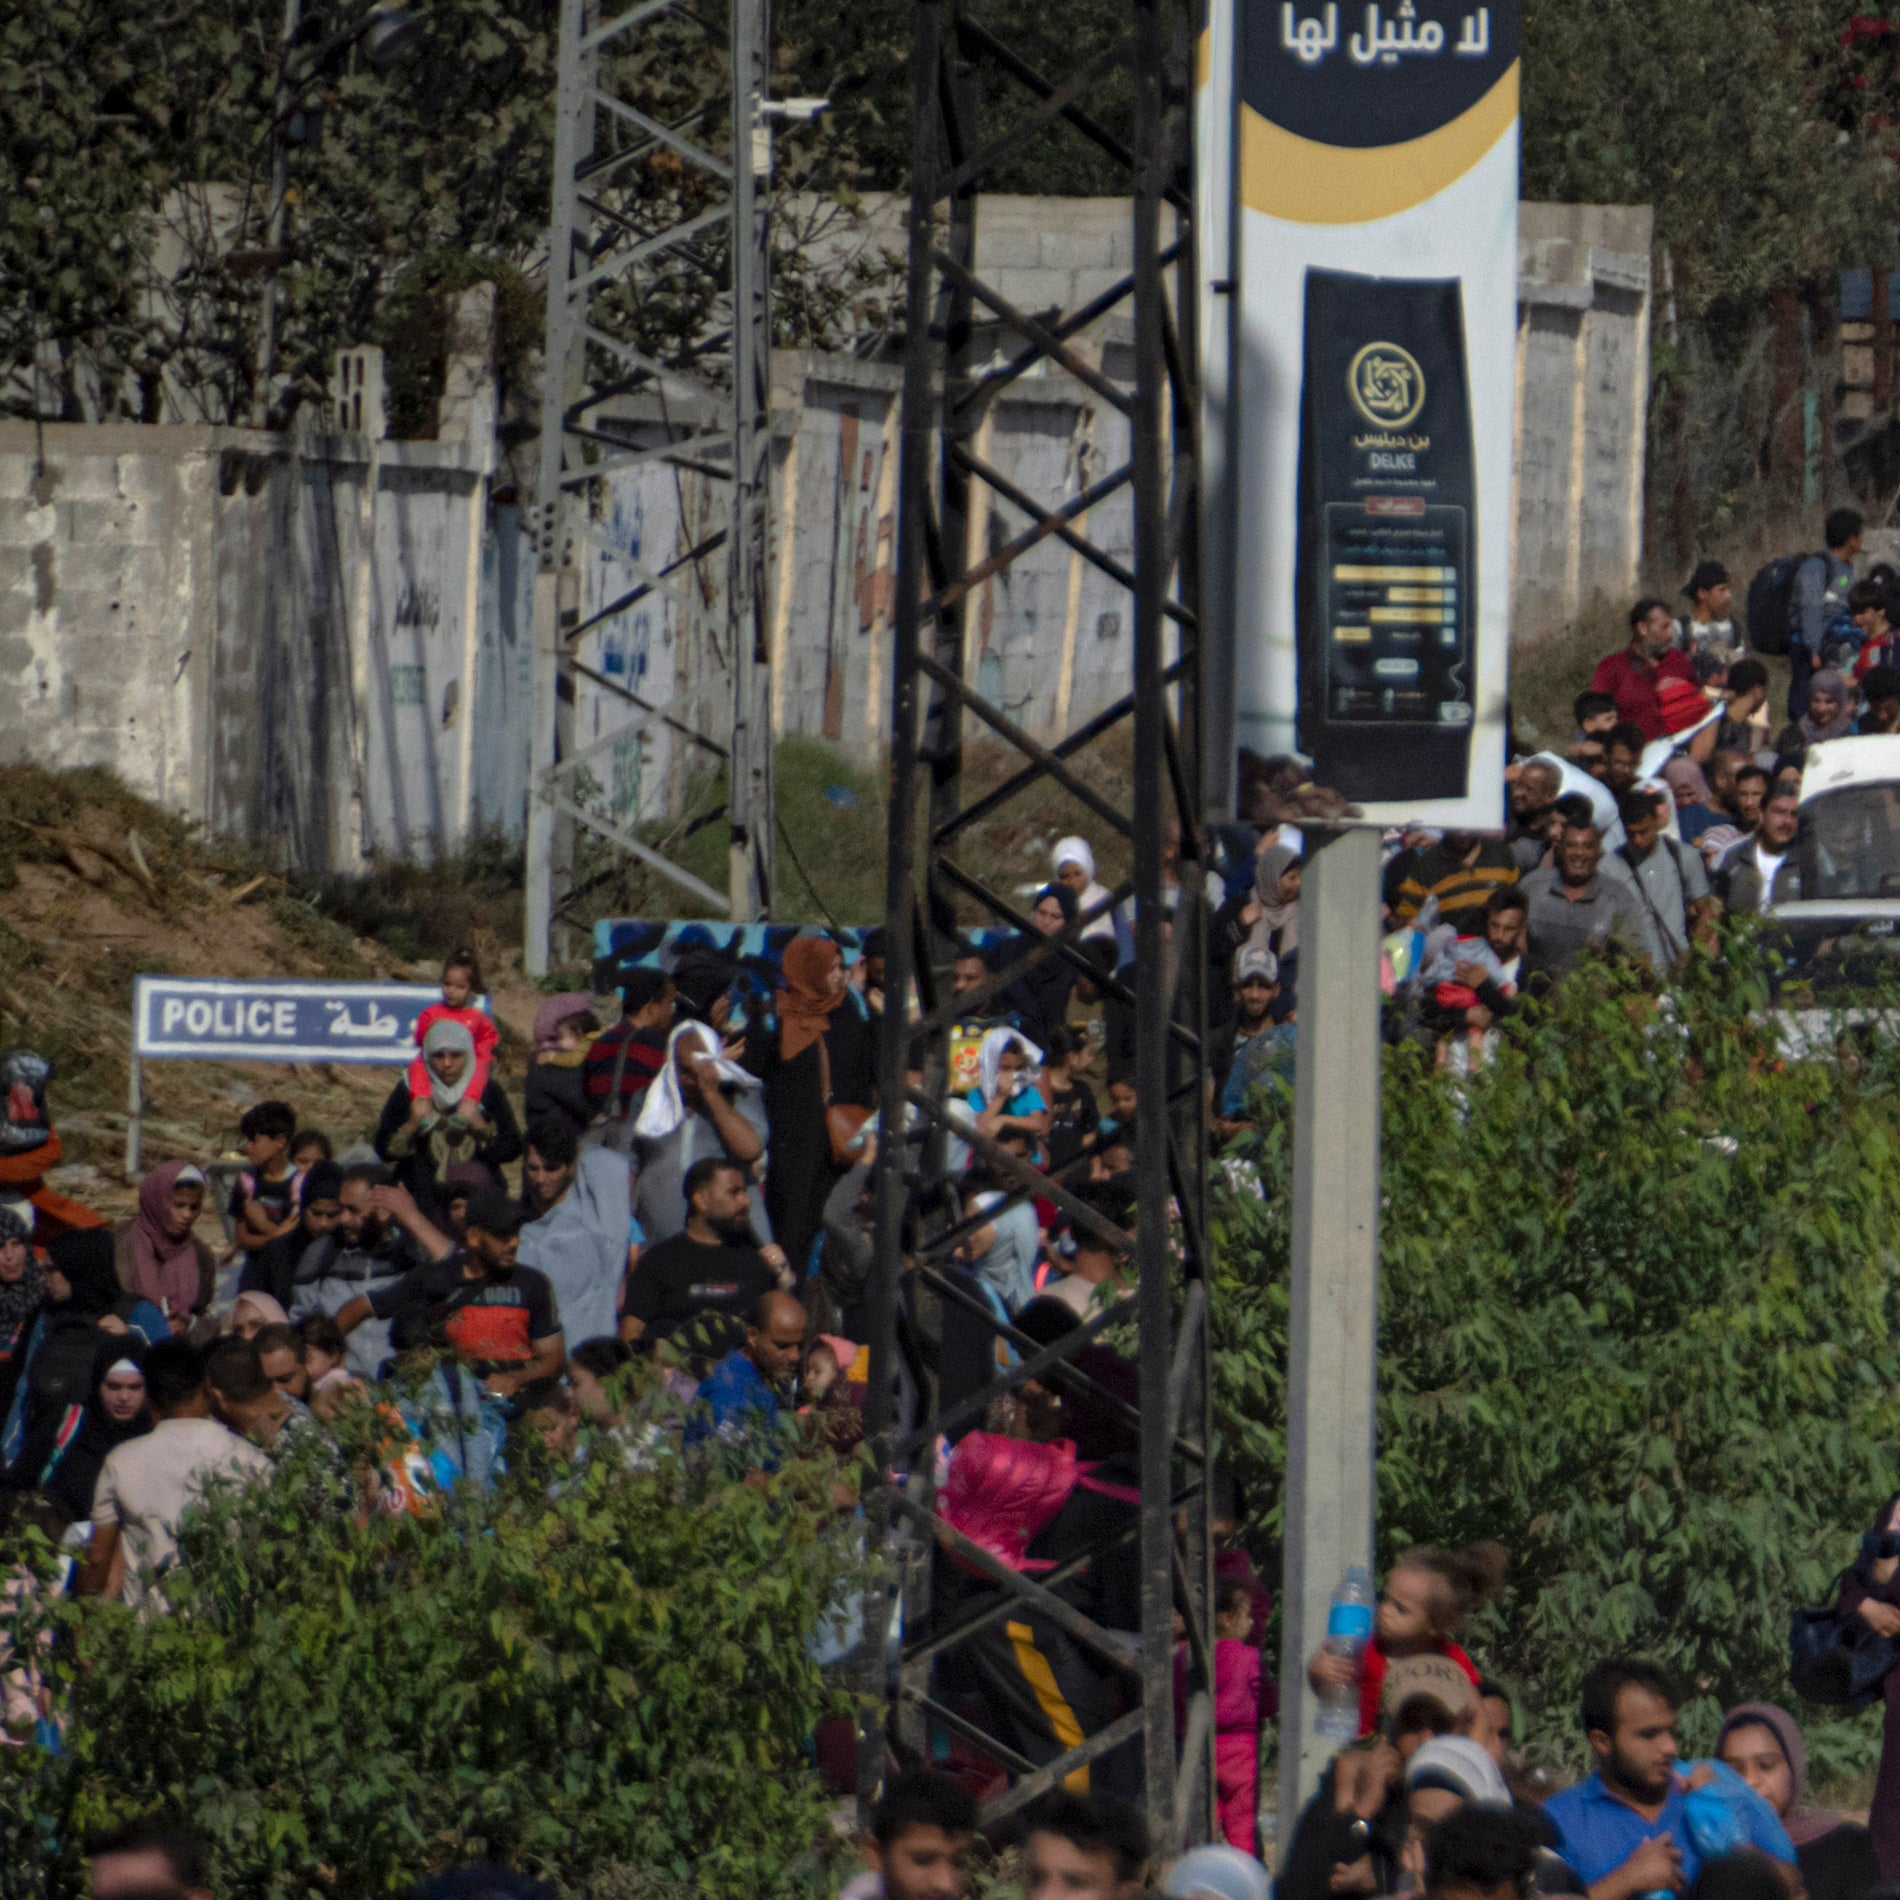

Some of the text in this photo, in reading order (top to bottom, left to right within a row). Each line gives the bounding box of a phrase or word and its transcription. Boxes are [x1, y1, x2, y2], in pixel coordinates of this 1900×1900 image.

[1284, 0, 1488, 63] لا مثيل لها
[1370, 452, 1416, 469] DELICE
[162, 997, 298, 1037] POLICE
